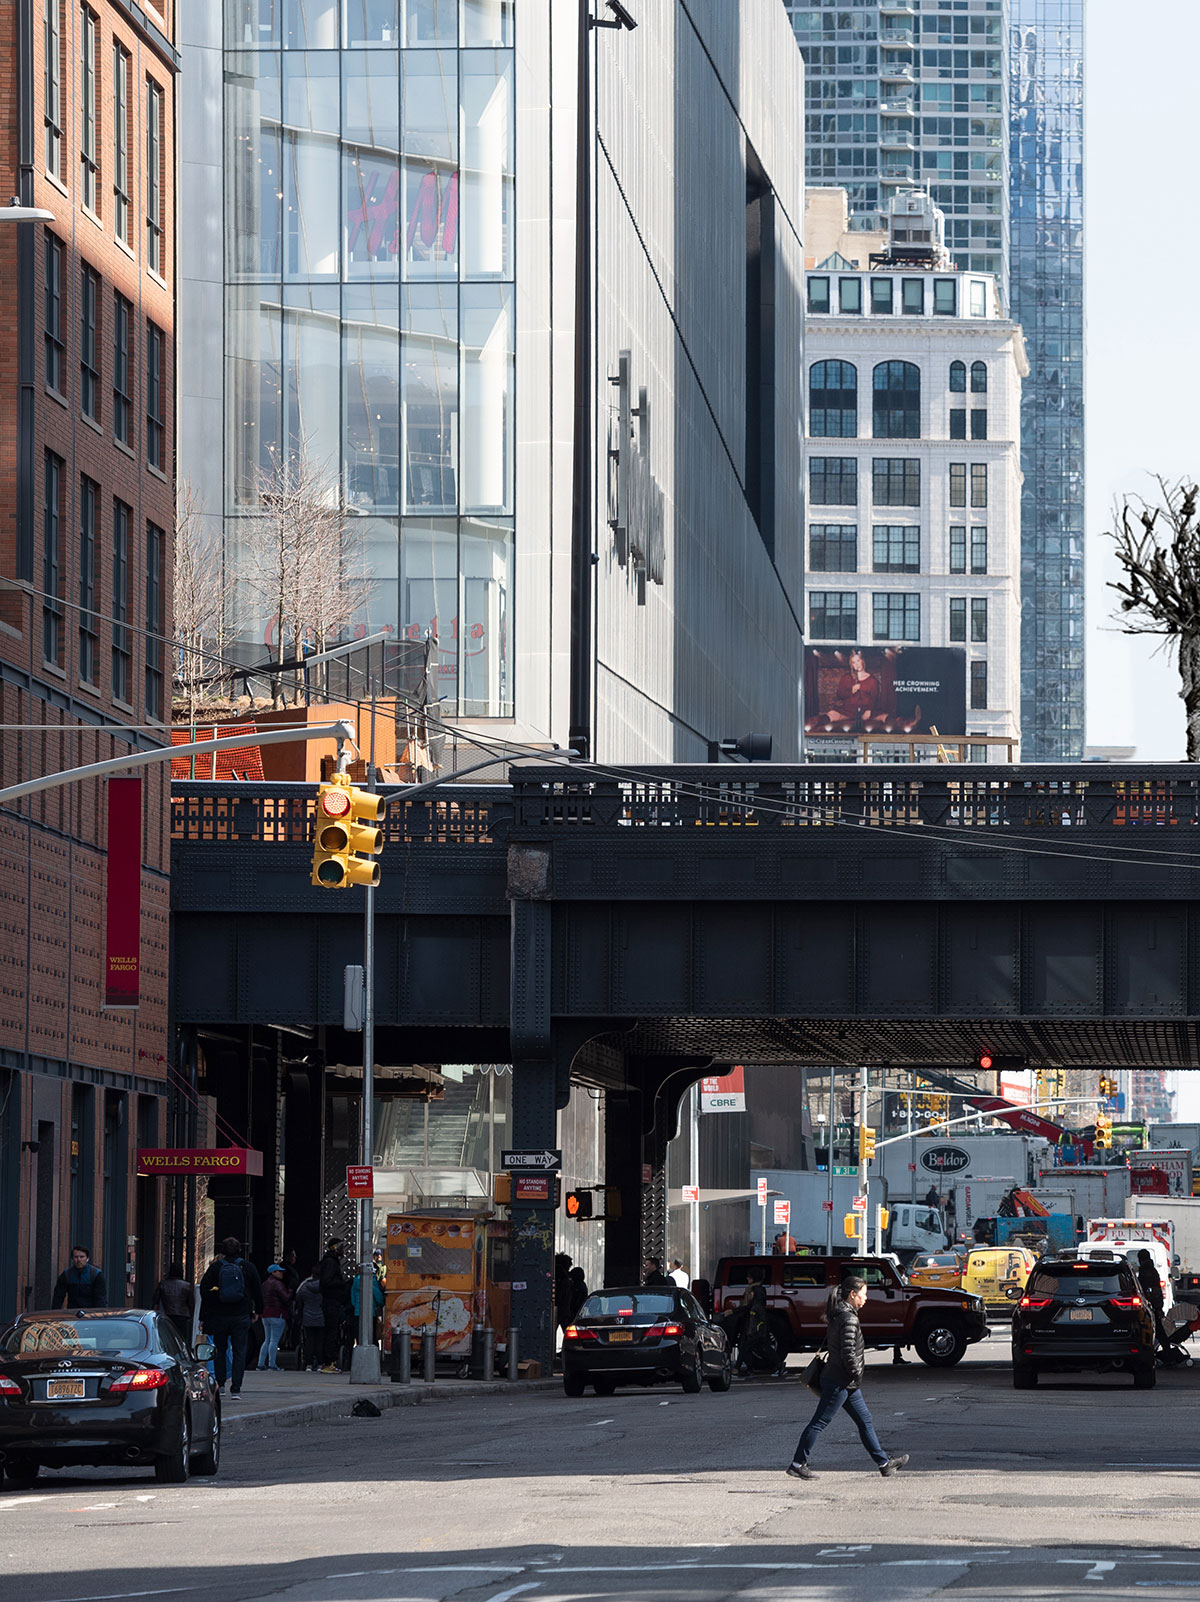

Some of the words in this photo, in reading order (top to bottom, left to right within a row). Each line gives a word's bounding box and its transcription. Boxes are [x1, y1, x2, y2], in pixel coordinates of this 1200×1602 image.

[710, 1098, 736, 1107] CBRE
[141, 1156, 191, 1167] WELLS
[193, 1156, 240, 1167] FARGO
[509, 1155, 527, 1164] ONE
[534, 1155, 553, 1164] WAY
[929, 1151, 966, 1167] Bldor
